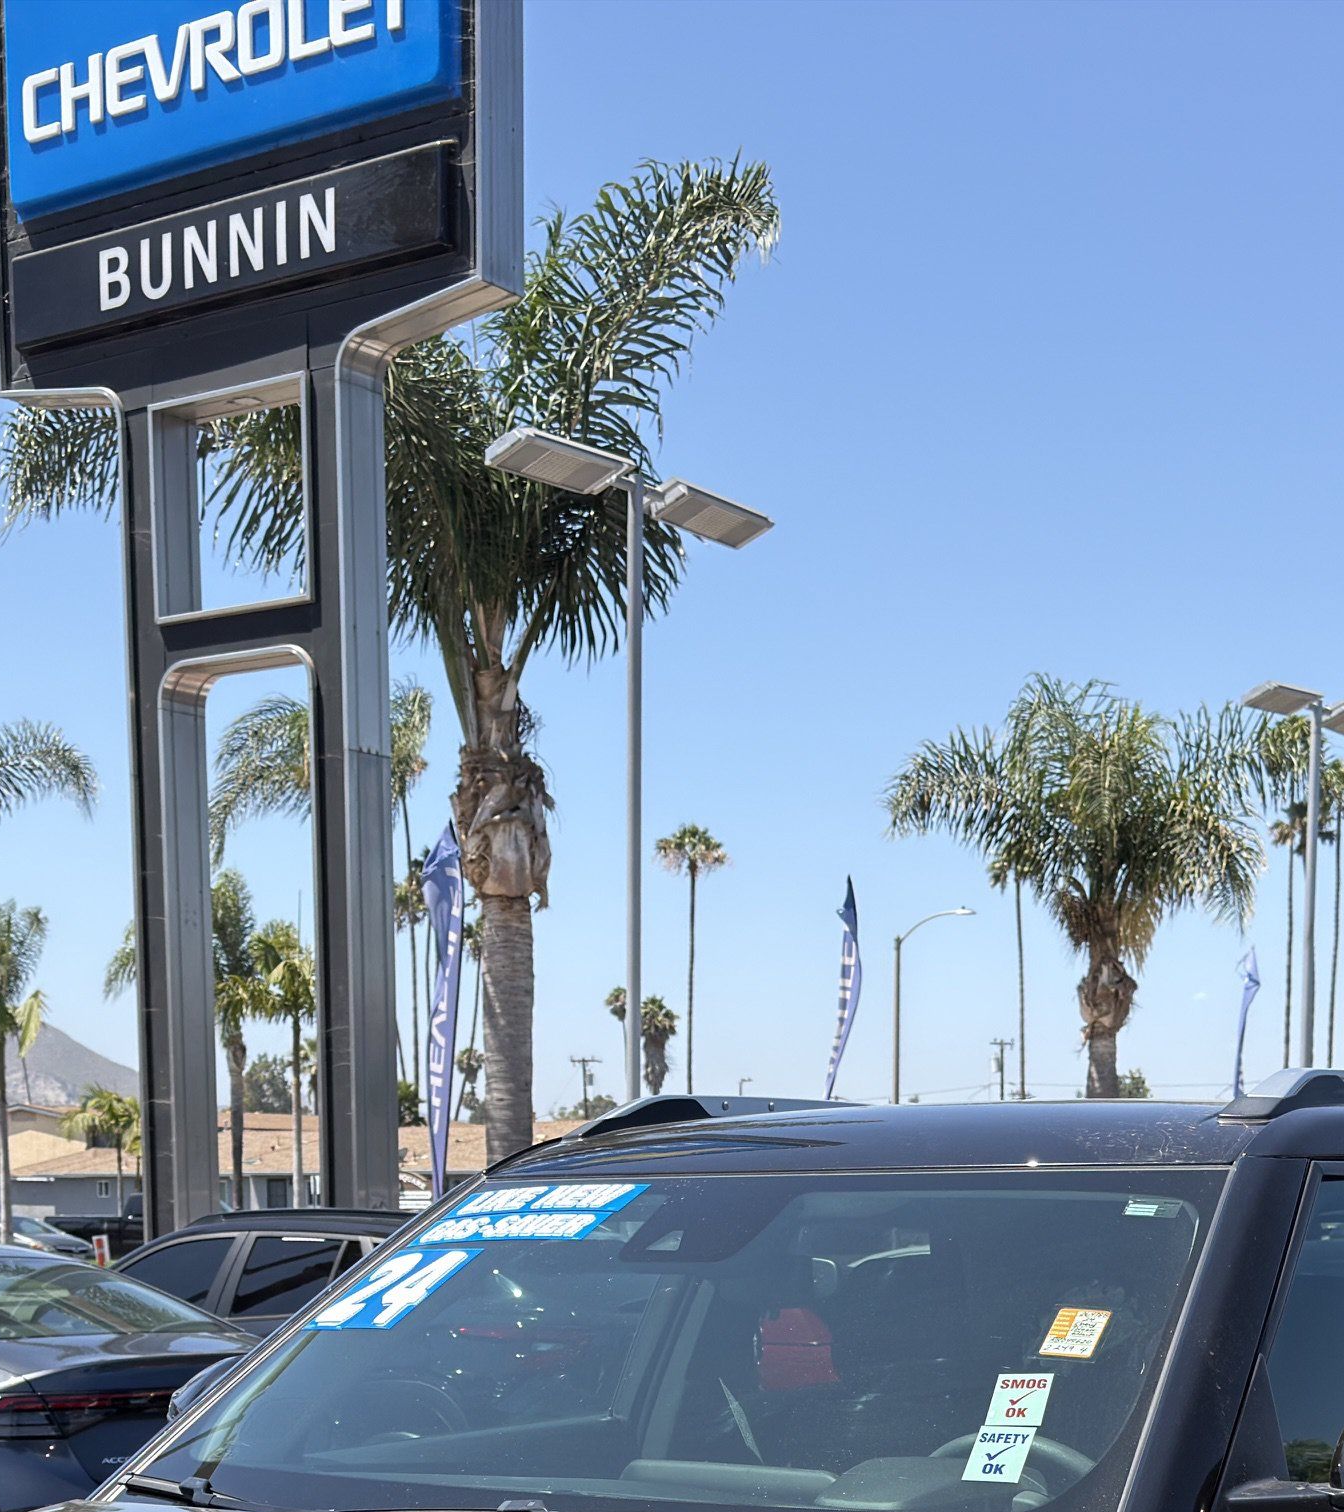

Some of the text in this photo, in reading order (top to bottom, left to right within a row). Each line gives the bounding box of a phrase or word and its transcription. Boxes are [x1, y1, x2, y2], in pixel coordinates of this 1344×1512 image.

[99, 186, 337, 311] BUNNIN
[456, 1187, 549, 1216] LIKE
[530, 1184, 636, 1210] NEW
[419, 1213, 597, 1244] GAS-SAVER
[999, 1378, 1048, 1391] SMOG
[1005, 1406, 1027, 1419] OK
[979, 1432, 1030, 1446] SAFETY
[981, 1463, 1005, 1476] OK
